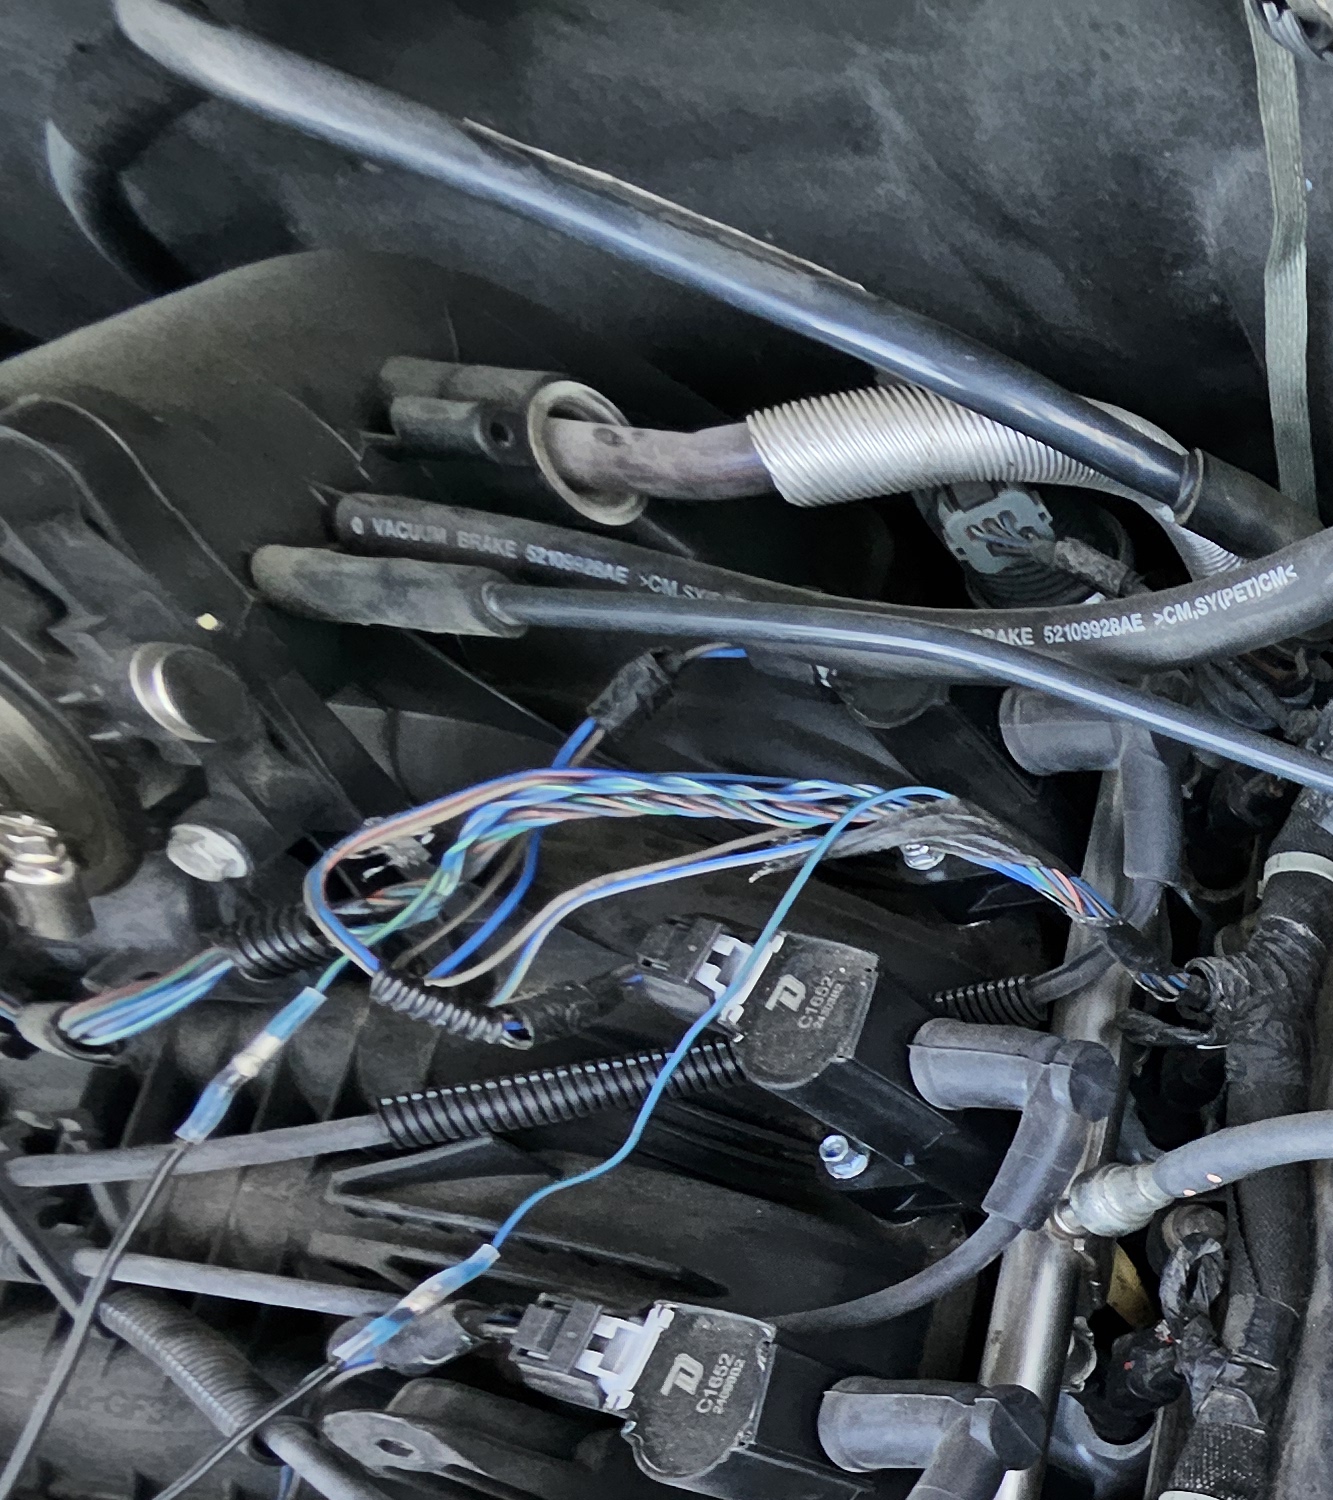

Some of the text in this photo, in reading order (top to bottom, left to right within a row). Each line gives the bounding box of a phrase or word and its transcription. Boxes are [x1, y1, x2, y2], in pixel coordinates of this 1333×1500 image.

[372, 517, 518, 560] VACUUM BRAKE
[1043, 613, 1146, 645] 52109928AE
